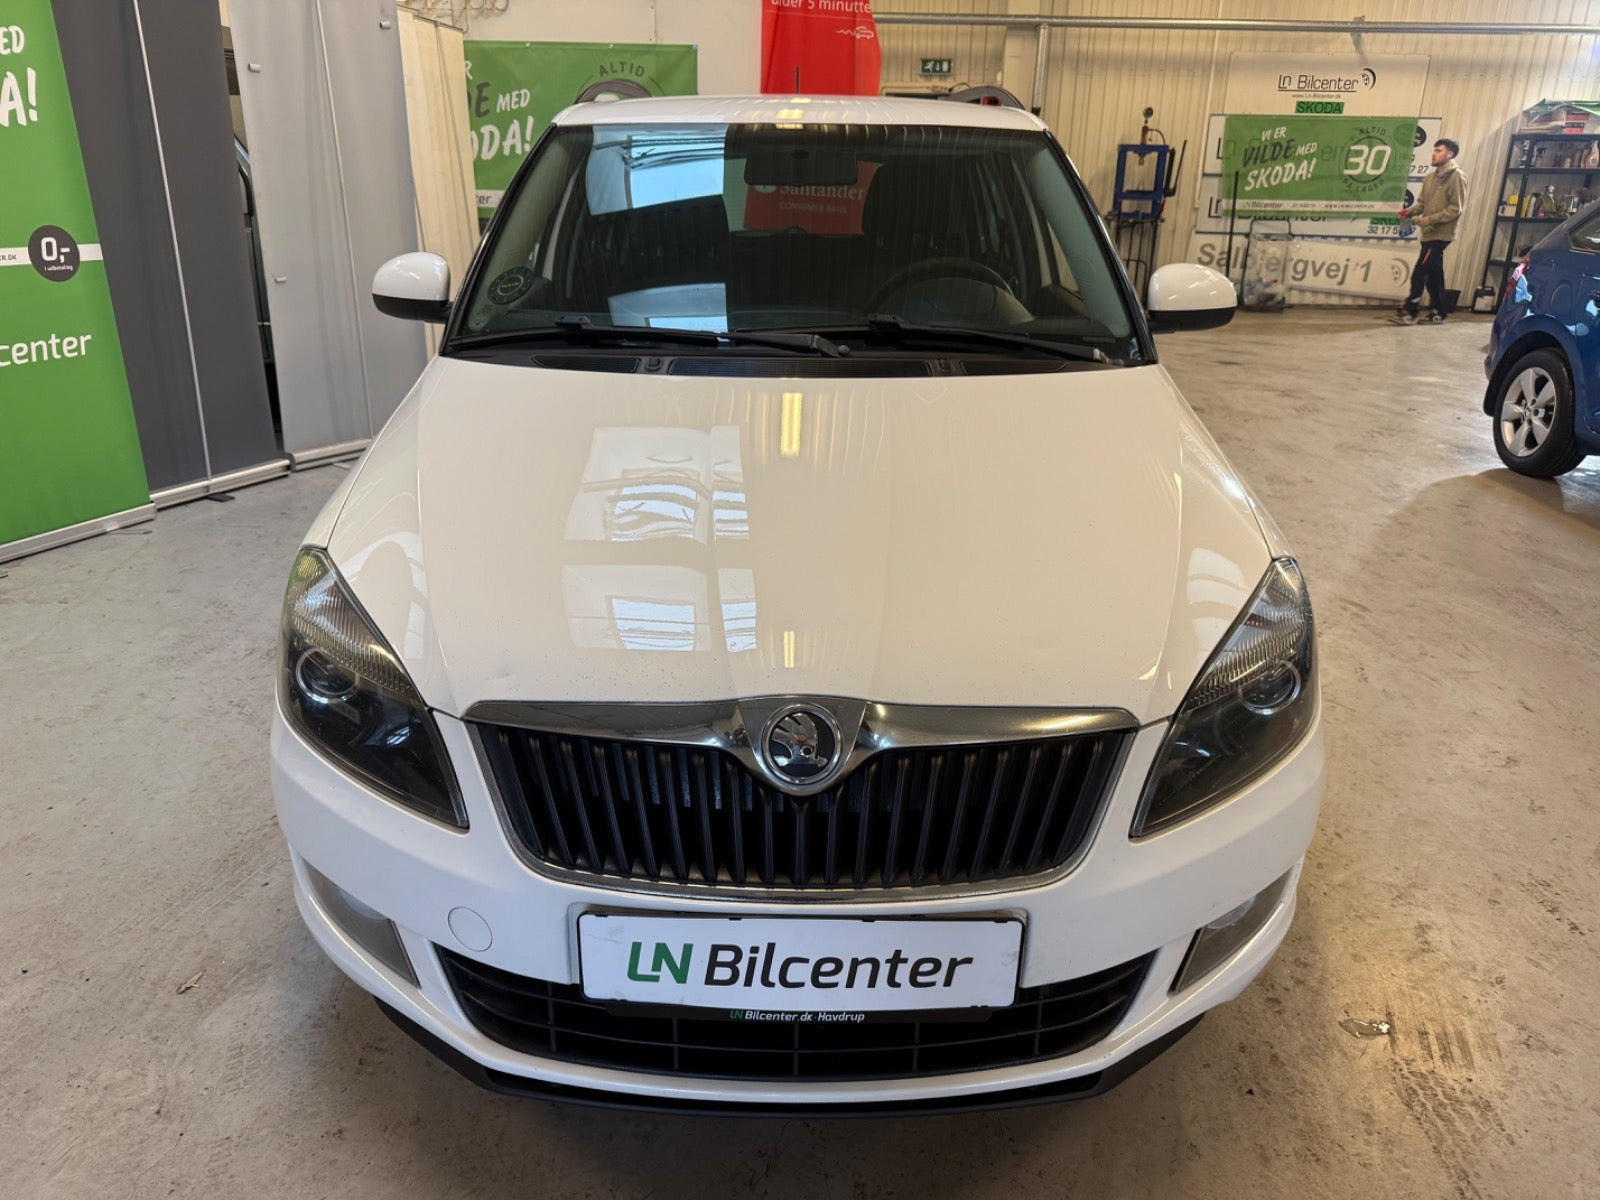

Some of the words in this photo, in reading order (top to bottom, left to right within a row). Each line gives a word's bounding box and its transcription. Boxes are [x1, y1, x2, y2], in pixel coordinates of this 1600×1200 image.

[599, 61, 645, 78] ALTID
[1297, 75, 1359, 90] Bilcenter
[496, 88, 531, 113] MED
[1295, 101, 1342, 113] SKODA
[1261, 129, 1272, 141] VI
[1273, 126, 1287, 139] ER
[1243, 138, 1295, 168] VILDE
[1296, 142, 1318, 157] MED
[1343, 144, 1392, 175] 30
[1245, 157, 1317, 191] SKODA!
[1360, 259, 1373, 283] 1
[627, 941, 694, 984] LN
[704, 942, 974, 988] Bilcenter
[744, 1010, 813, 1022] Bilcenter.dk
[817, 1011, 865, 1023] Havdrup
